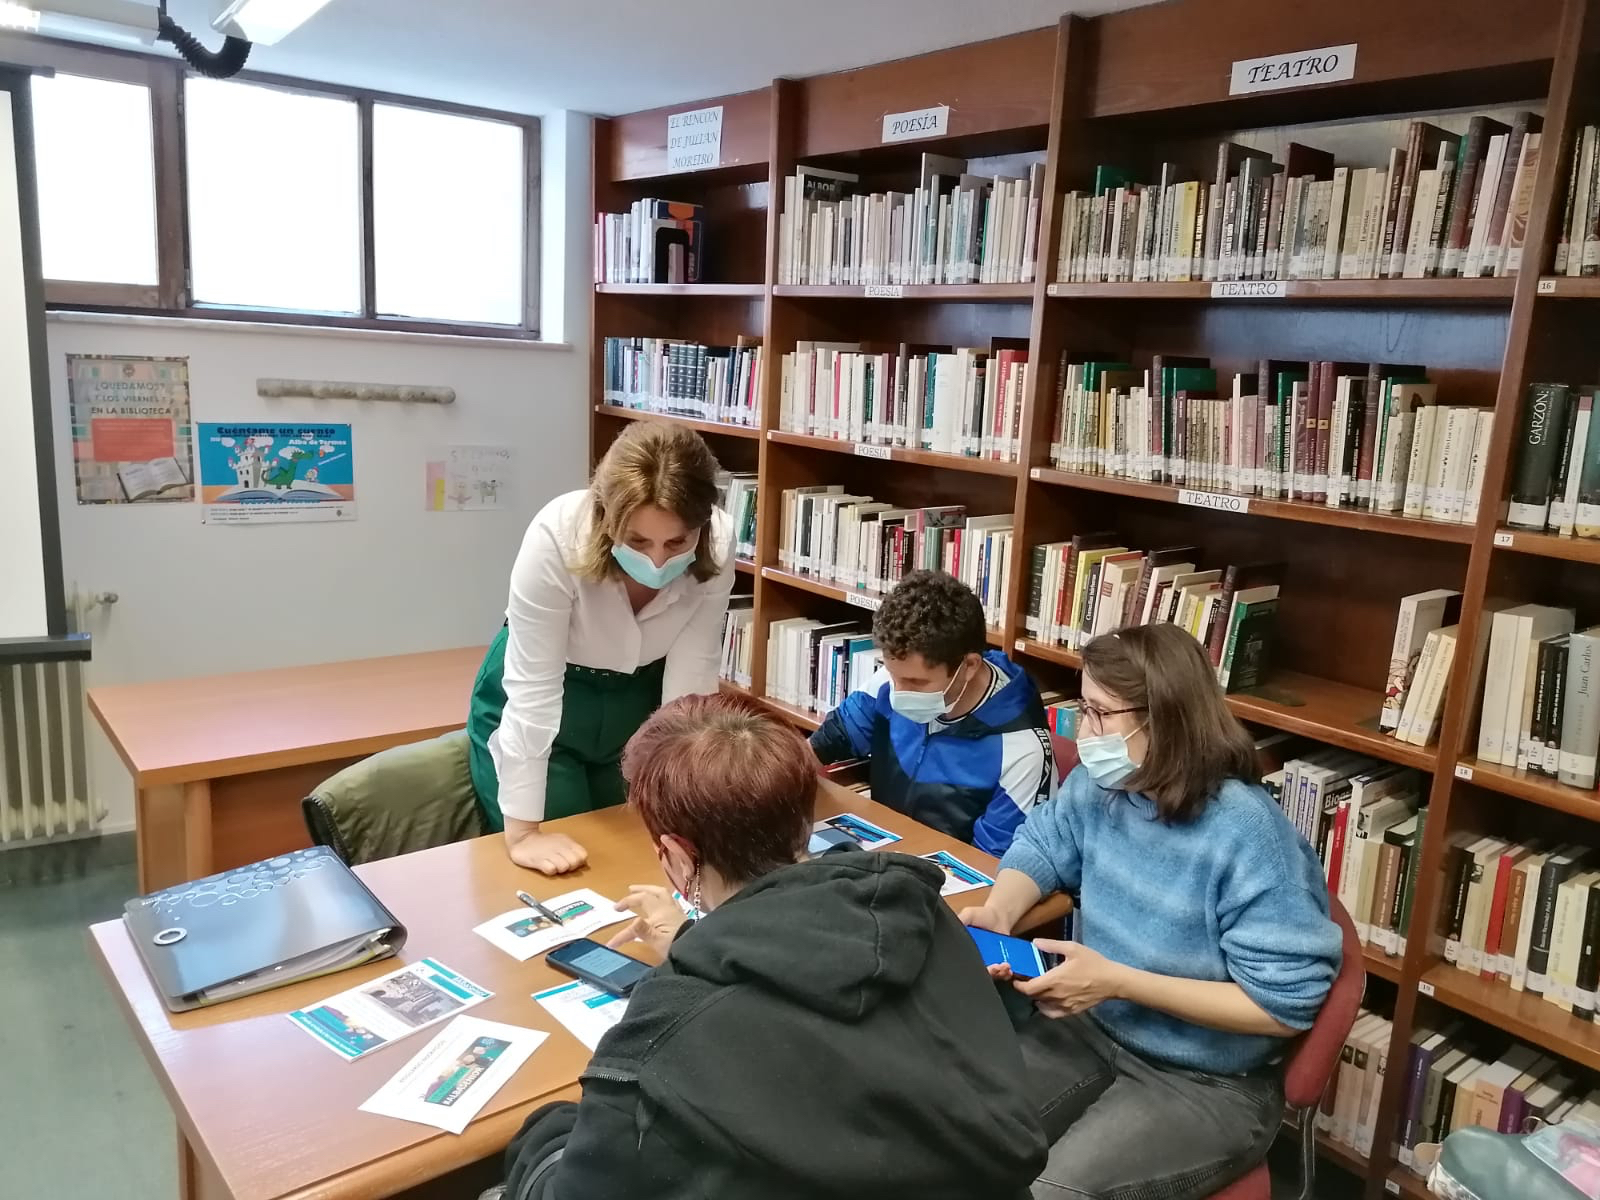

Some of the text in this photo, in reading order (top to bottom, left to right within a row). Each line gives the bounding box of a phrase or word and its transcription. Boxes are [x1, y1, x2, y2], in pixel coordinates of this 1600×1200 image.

[1247, 54, 1339, 84] TEATRO
[892, 113, 938, 135] POESÍA
[1219, 282, 1278, 296] TEATRO
[1541, 282, 1552, 290] 16
[91, 407, 171, 416] EN LA BIBLIOTECA
[1528, 390, 1550, 445] GARZÓN:
[279, 427, 294, 435] un
[1186, 492, 1241, 511] TEATRO
[1576, 644, 1593, 698] Juan Carlos
